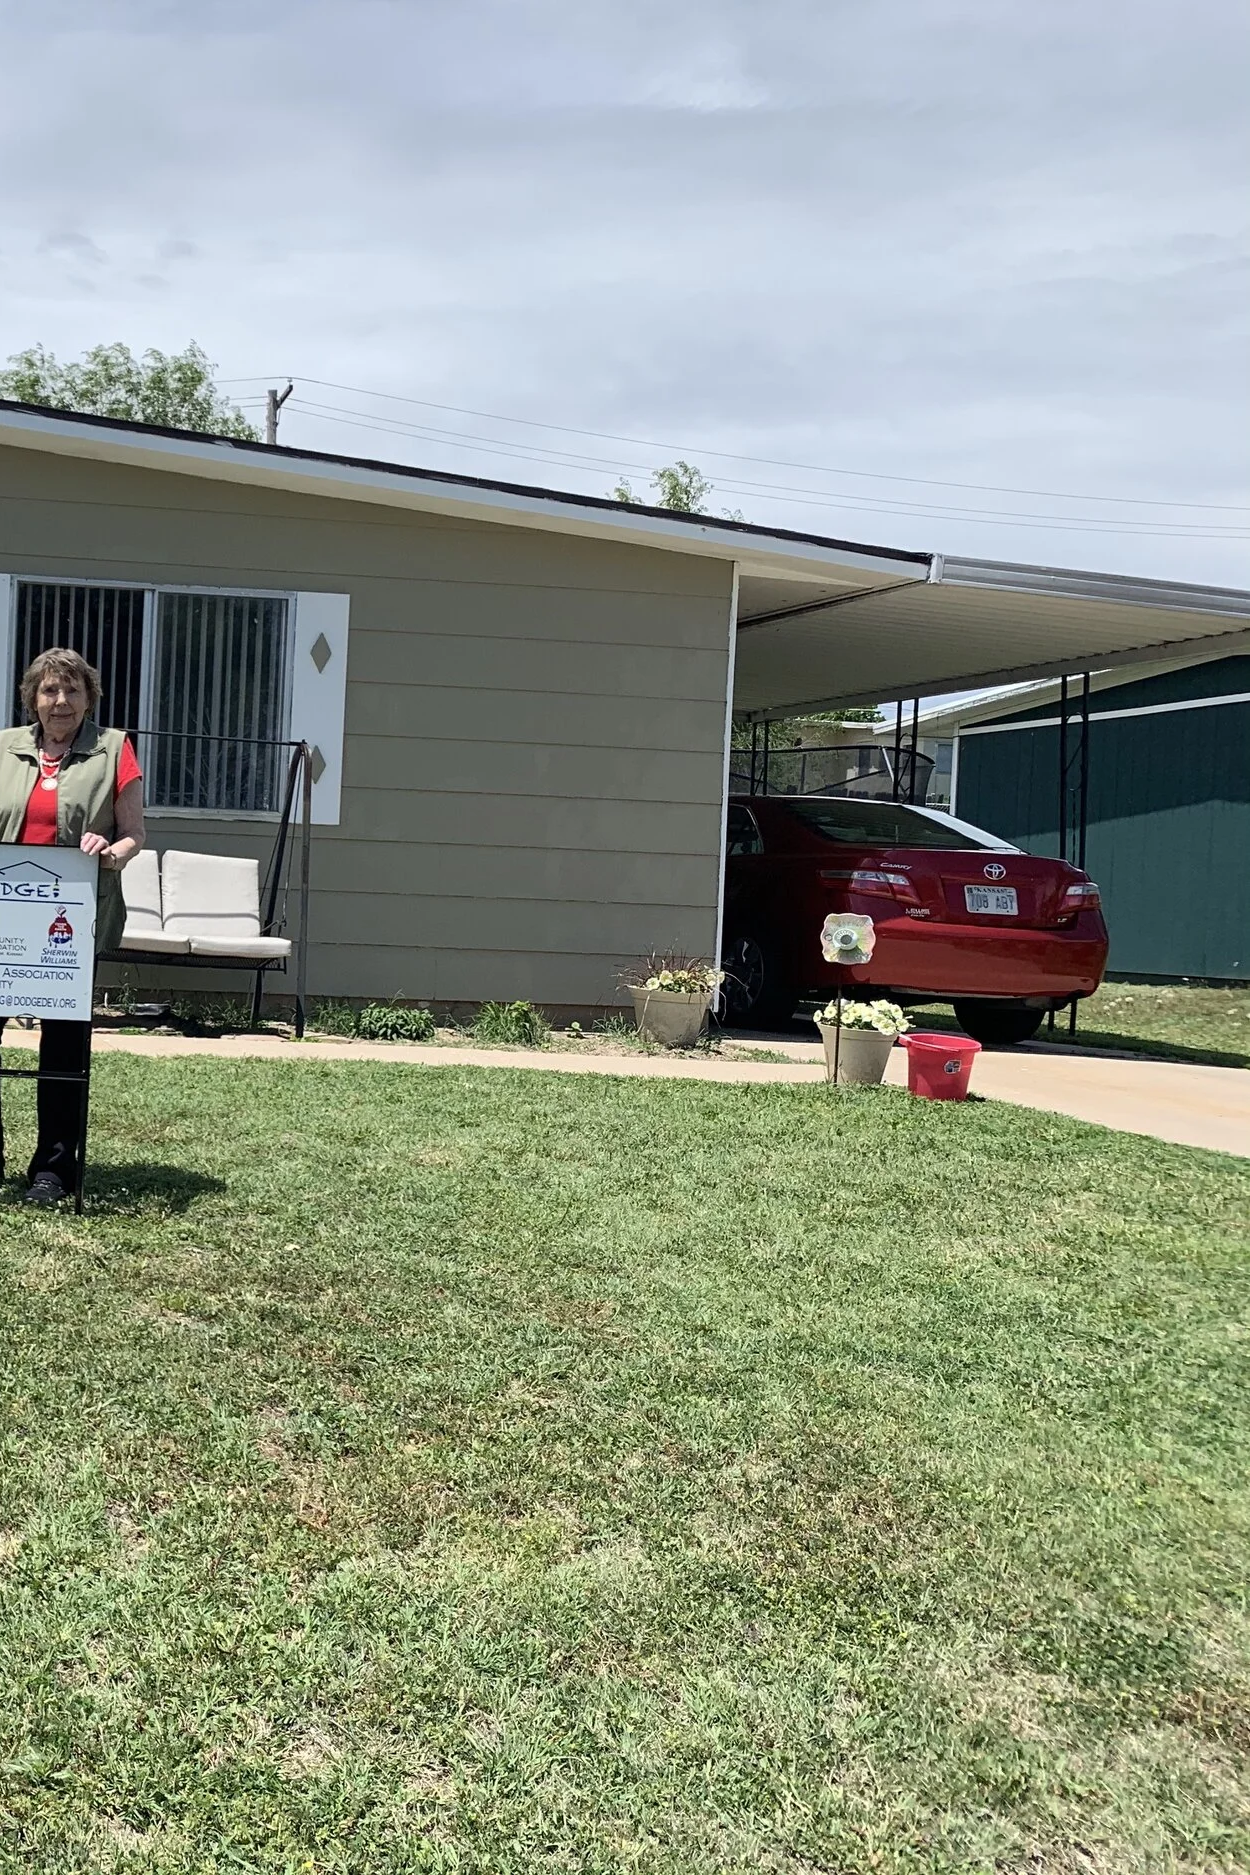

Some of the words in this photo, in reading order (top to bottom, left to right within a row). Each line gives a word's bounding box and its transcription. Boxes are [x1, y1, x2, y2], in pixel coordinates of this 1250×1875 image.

[41, 947, 78, 957] SHERWIN
[40, 956, 77, 965] WILLIAMS
[2, 967, 74, 981] ASSOCIATION
